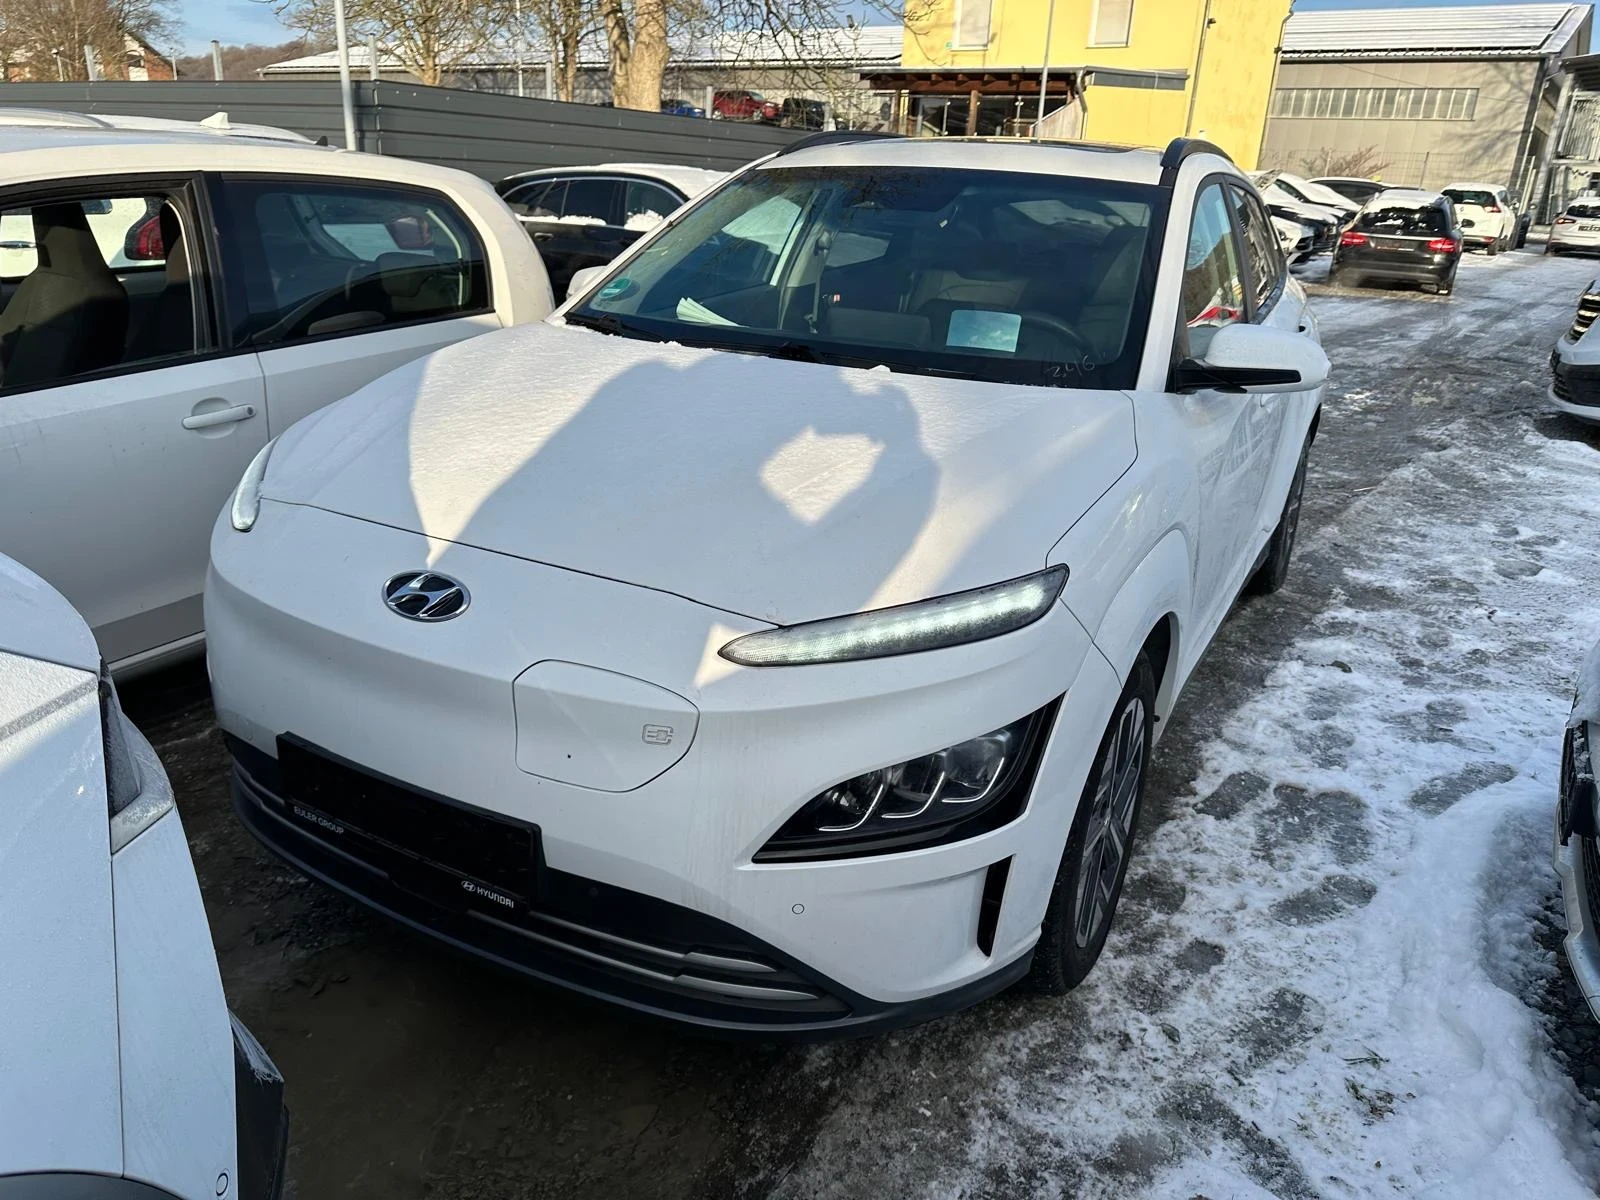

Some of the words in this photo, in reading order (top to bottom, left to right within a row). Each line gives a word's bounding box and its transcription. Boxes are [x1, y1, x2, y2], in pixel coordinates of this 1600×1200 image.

[293, 805, 318, 823] EULER
[317, 817, 345, 834] GROUP
[477, 886, 515, 909] HYUNDAI
